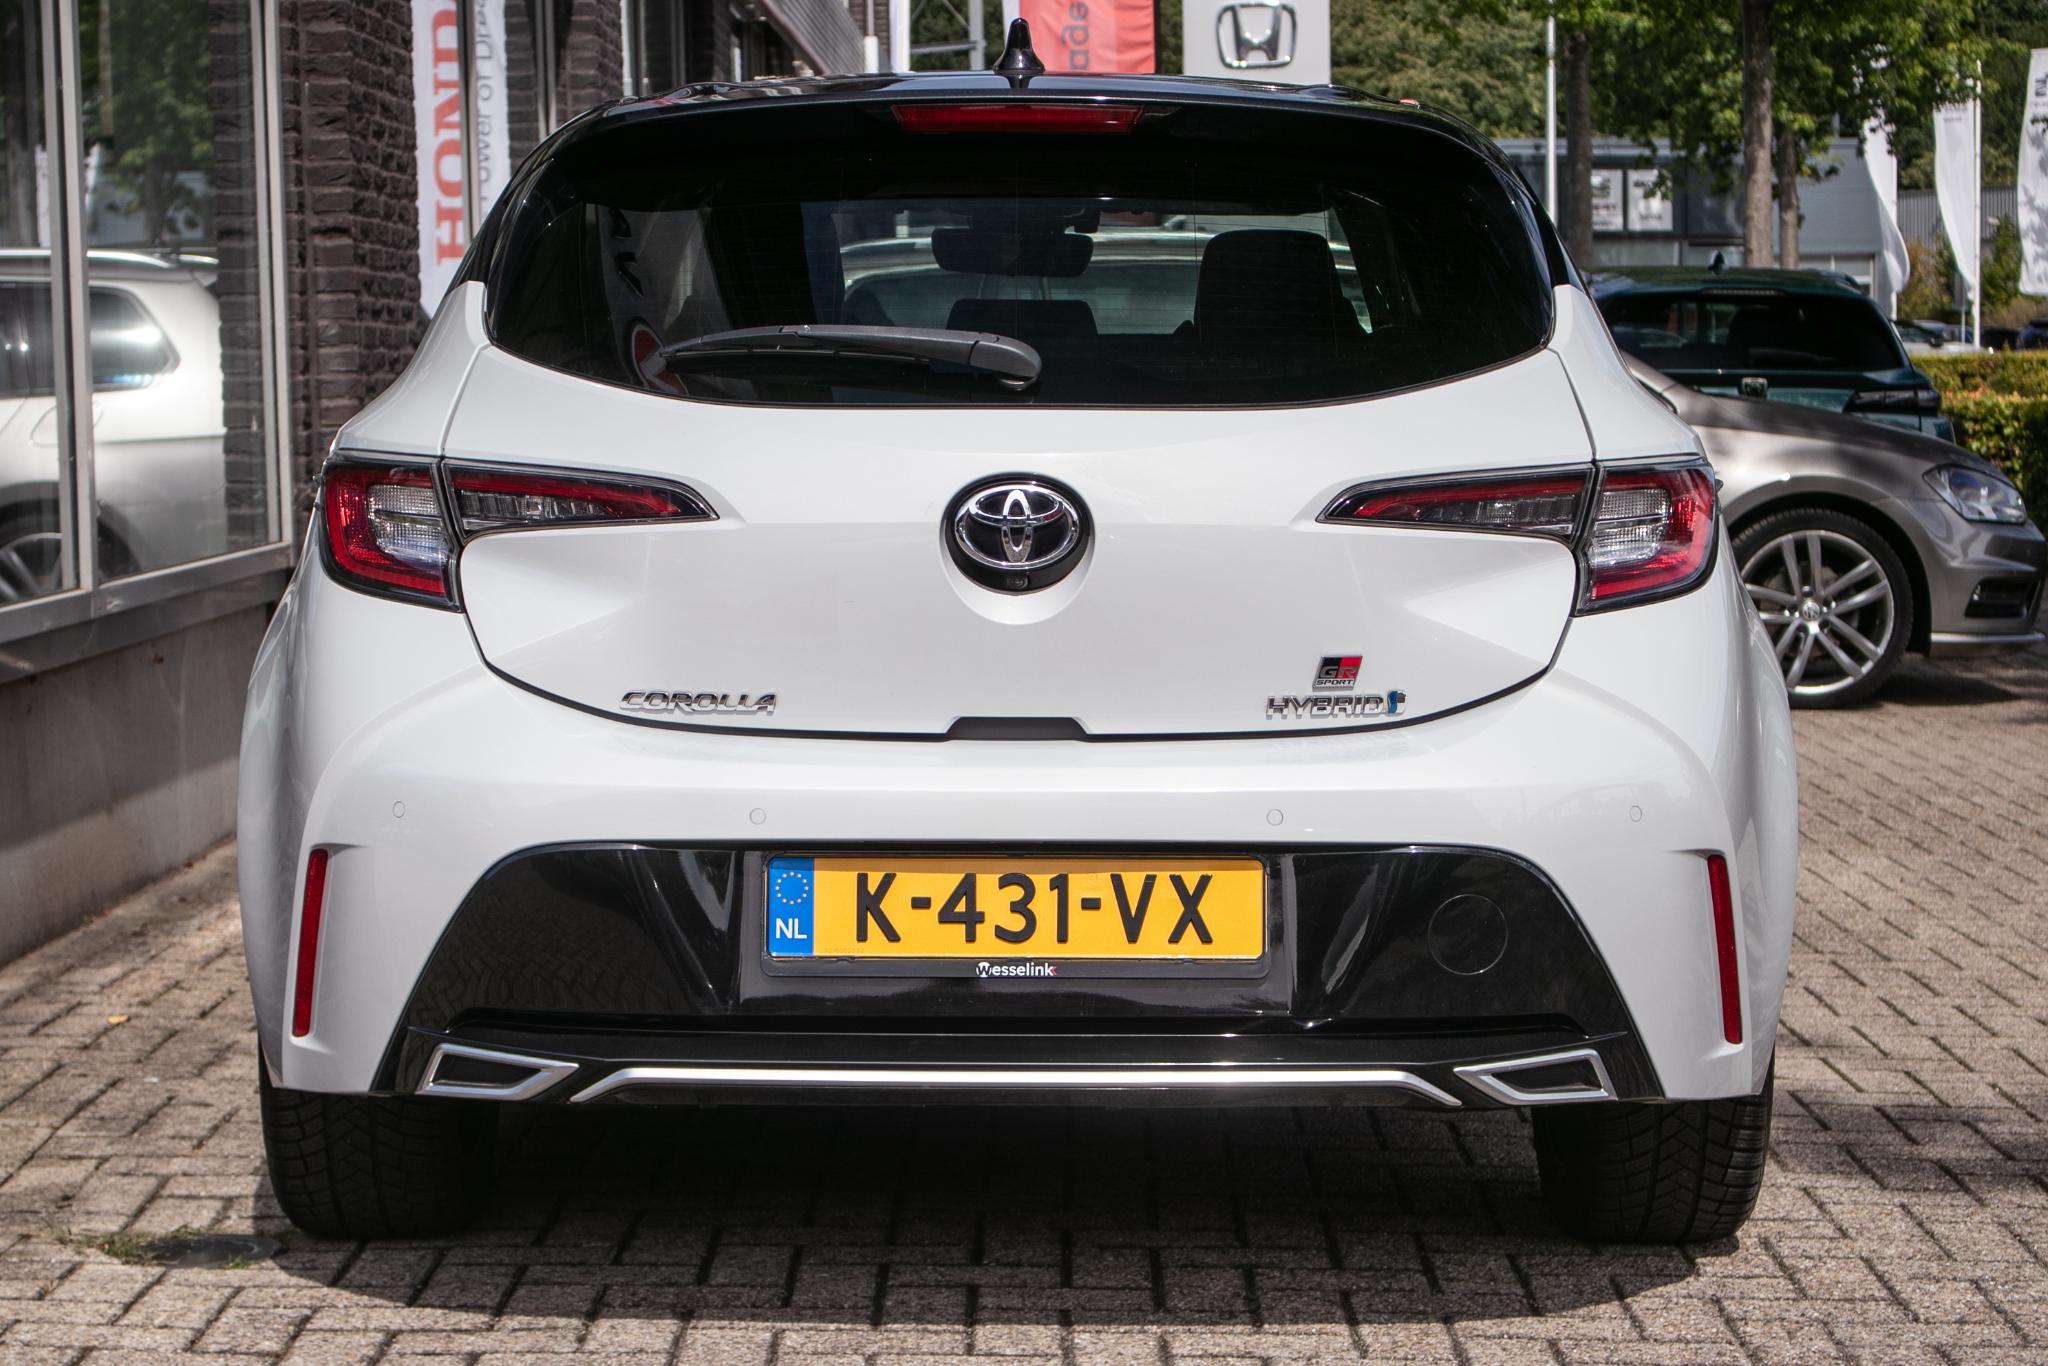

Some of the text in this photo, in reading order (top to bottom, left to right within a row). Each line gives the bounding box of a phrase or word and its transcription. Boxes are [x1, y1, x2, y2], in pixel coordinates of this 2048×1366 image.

[431, 0, 465, 267] HOND
[1318, 665, 1358, 679] GR
[619, 690, 777, 714] COROLLA
[1266, 695, 1384, 719] HYBRID
[855, 872, 1214, 943] K-431-VX
[775, 918, 808, 939] NL
[976, 961, 1056, 978] Wesselink
